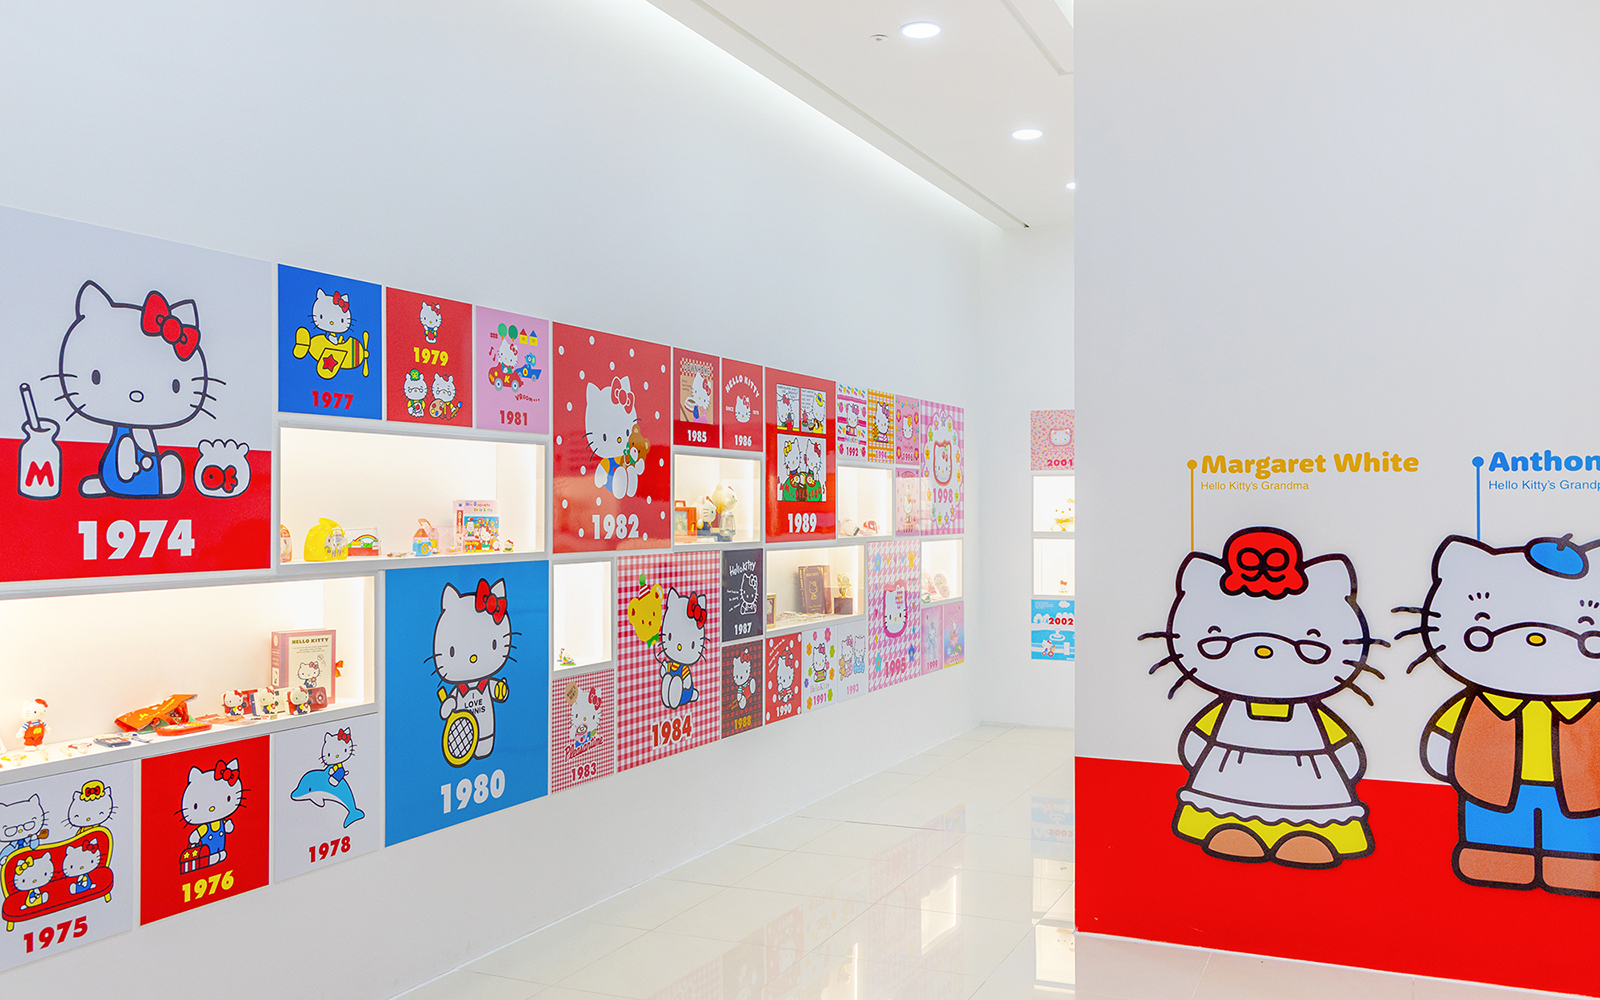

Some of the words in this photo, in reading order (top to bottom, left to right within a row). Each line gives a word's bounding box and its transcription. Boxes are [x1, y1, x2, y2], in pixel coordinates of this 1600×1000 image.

[414, 346, 449, 367] 1979
[504, 375, 510, 383] K
[725, 374, 743, 394] HELLO
[744, 375, 760, 398] KITTY
[312, 390, 354, 410] 1977
[500, 409, 528, 426] 1981
[687, 429, 707, 443] 1985
[734, 434, 752, 447] 1986
[846, 446, 859, 457] 1992
[1047, 459, 1073, 467] 2001
[1201, 454, 1327, 480] Margaret
[1333, 450, 1420, 473] White
[1488, 449, 1600, 472] Anthon
[25, 460, 55, 488] M
[1200, 481, 1227, 490] Hello
[1229, 481, 1258, 492] Kitty's
[1261, 481, 1310, 490] Grandma
[1488, 480, 1519, 490] Hello
[1522, 480, 1556, 492] Kitty's
[933, 487, 953, 504] 1998
[592, 513, 639, 540] 1982
[788, 512, 817, 534] 1989
[78, 519, 195, 561] 1974
[729, 562, 743, 577] Hello
[734, 621, 753, 636] 1987
[1048, 616, 1074, 626] 2002
[885, 656, 906, 679] 1995
[847, 683, 860, 696] 1993
[464, 698, 483, 709] LOVE
[813, 692, 827, 706] 1991
[776, 702, 792, 717] 1990
[734, 714, 752, 730] 1988
[651, 714, 693, 748] 1984
[571, 762, 597, 782] 1983
[440, 768, 506, 815] 1980
[308, 835, 352, 863] 1978
[182, 869, 235, 903] 1976
[23, 915, 89, 954] 1975
